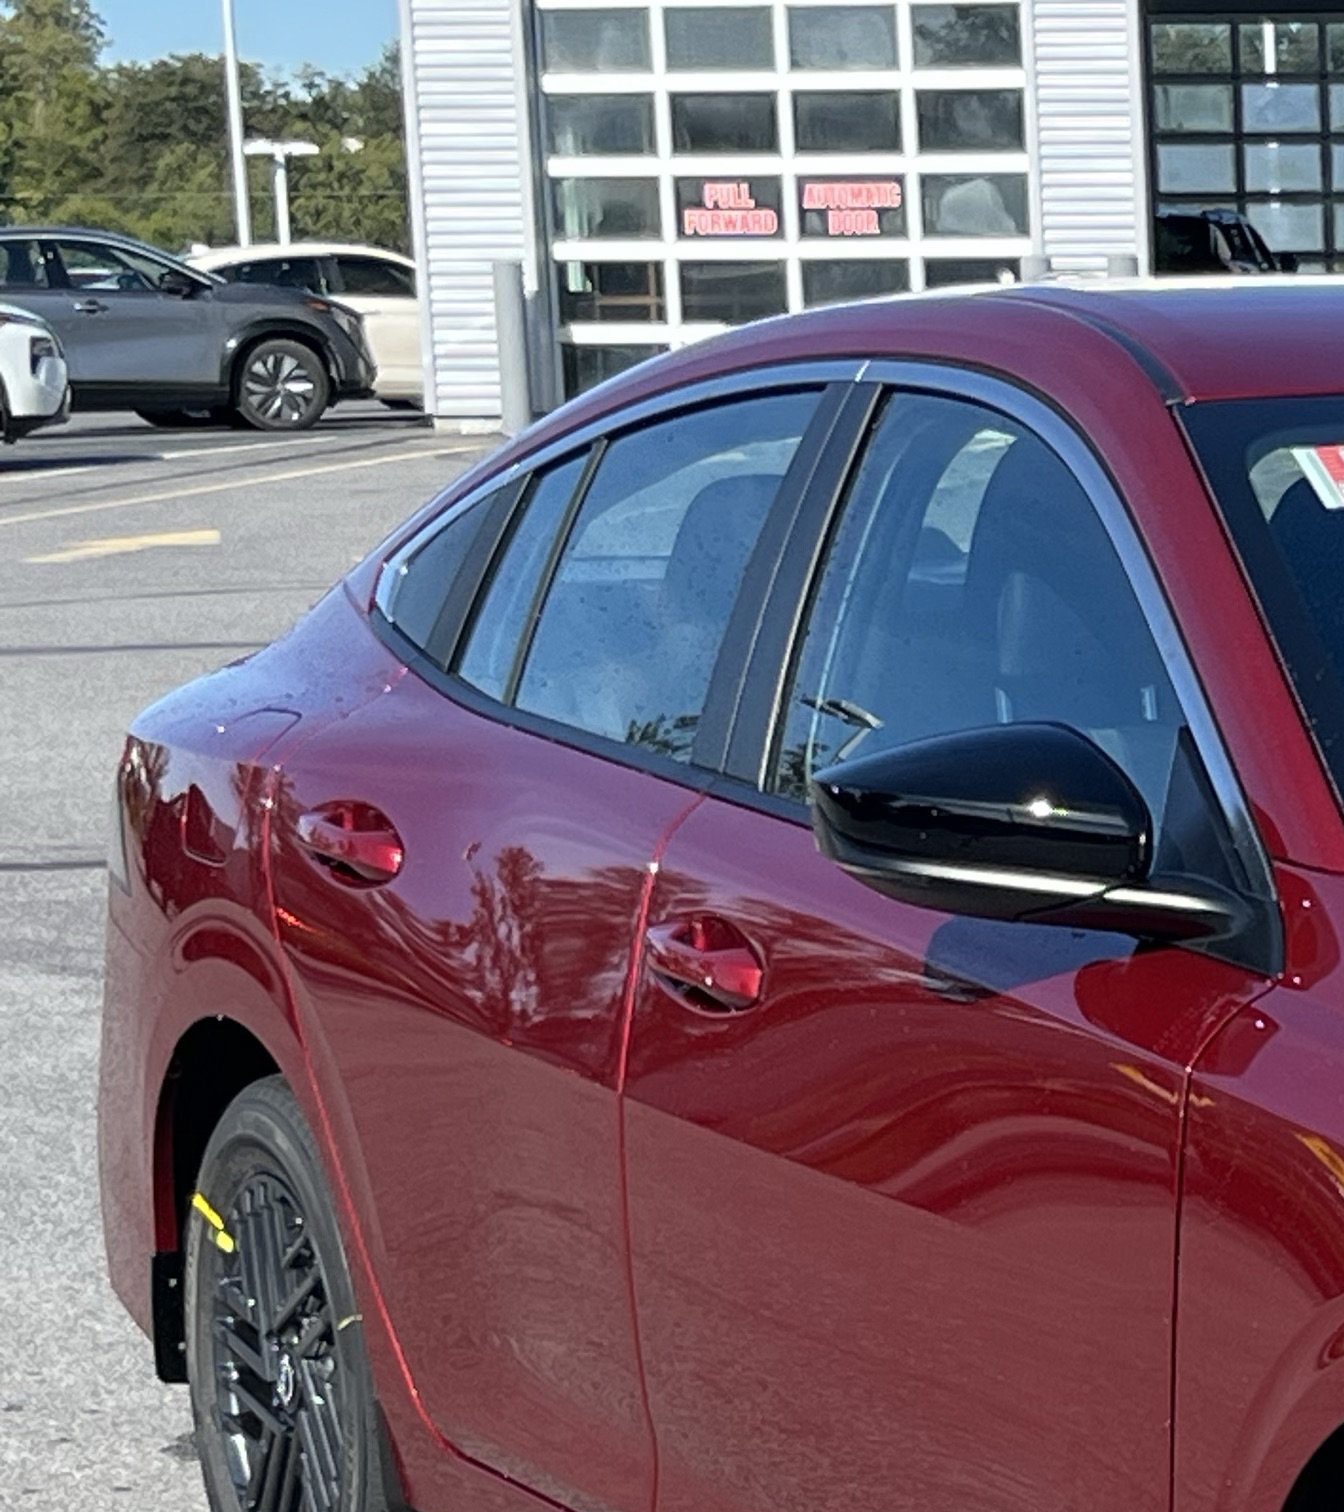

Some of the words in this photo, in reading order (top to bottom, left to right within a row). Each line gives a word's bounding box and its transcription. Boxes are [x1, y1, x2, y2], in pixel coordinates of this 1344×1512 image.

[703, 182, 755, 209] PULL
[802, 182, 901, 209] AUTOMATIC
[684, 208, 778, 235] FORWARD
[828, 209, 880, 235] DOOR
